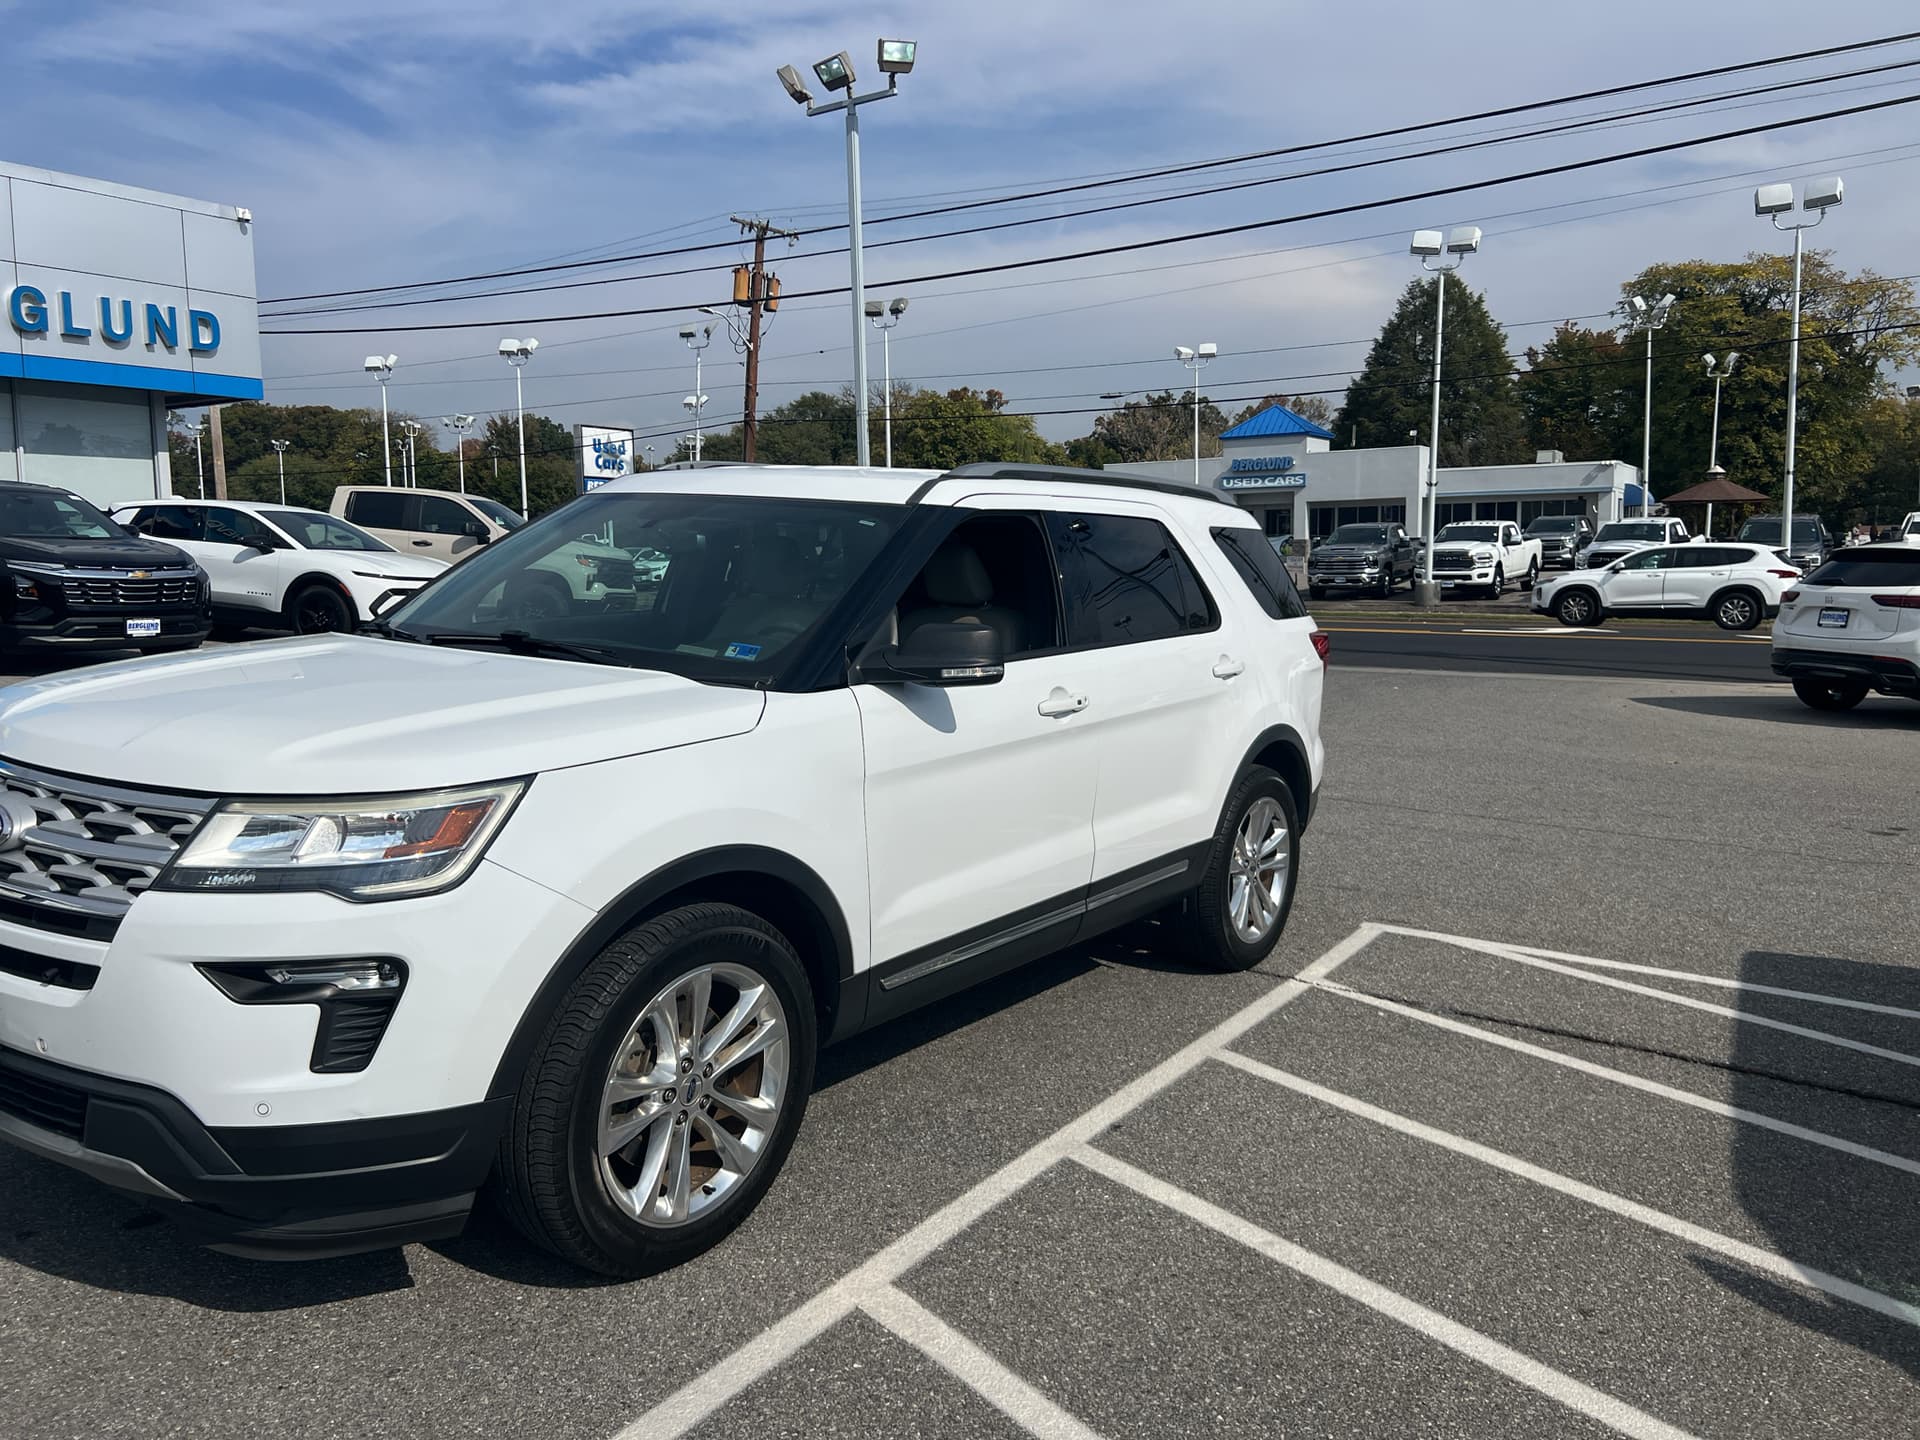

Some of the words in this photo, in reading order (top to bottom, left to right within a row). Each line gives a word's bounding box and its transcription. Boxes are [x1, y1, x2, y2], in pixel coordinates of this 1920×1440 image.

[9, 285, 221, 351] GLUND
[592, 438, 625, 455] Used
[595, 454, 624, 470] Cars
[1231, 457, 1294, 471] BERGLUND
[1223, 477, 1262, 488] USED
[1264, 475, 1304, 486] CARS
